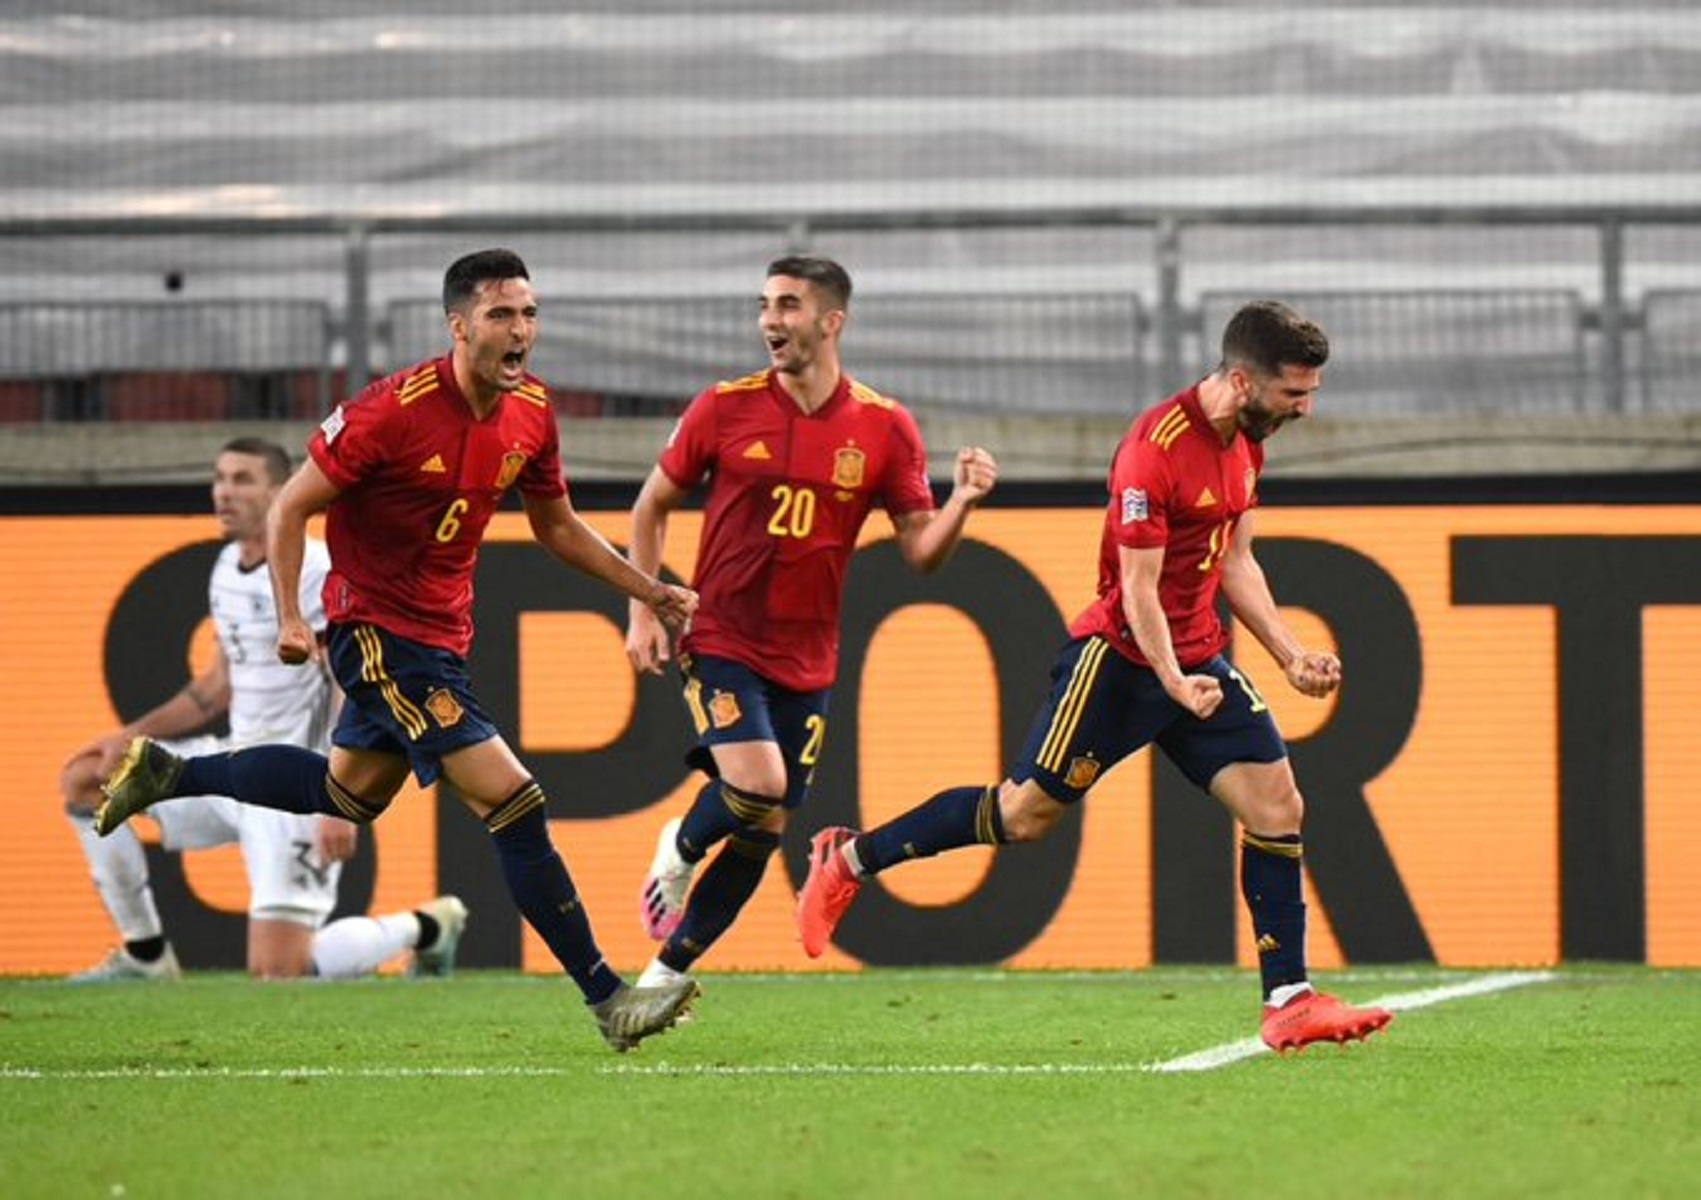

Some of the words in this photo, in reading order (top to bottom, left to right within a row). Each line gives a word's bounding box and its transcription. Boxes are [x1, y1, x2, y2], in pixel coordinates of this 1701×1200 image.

[436, 498, 468, 542] 6
[768, 485, 815, 539] 20
[104, 534, 1701, 970] SPORT
[291, 840, 329, 891] 3
